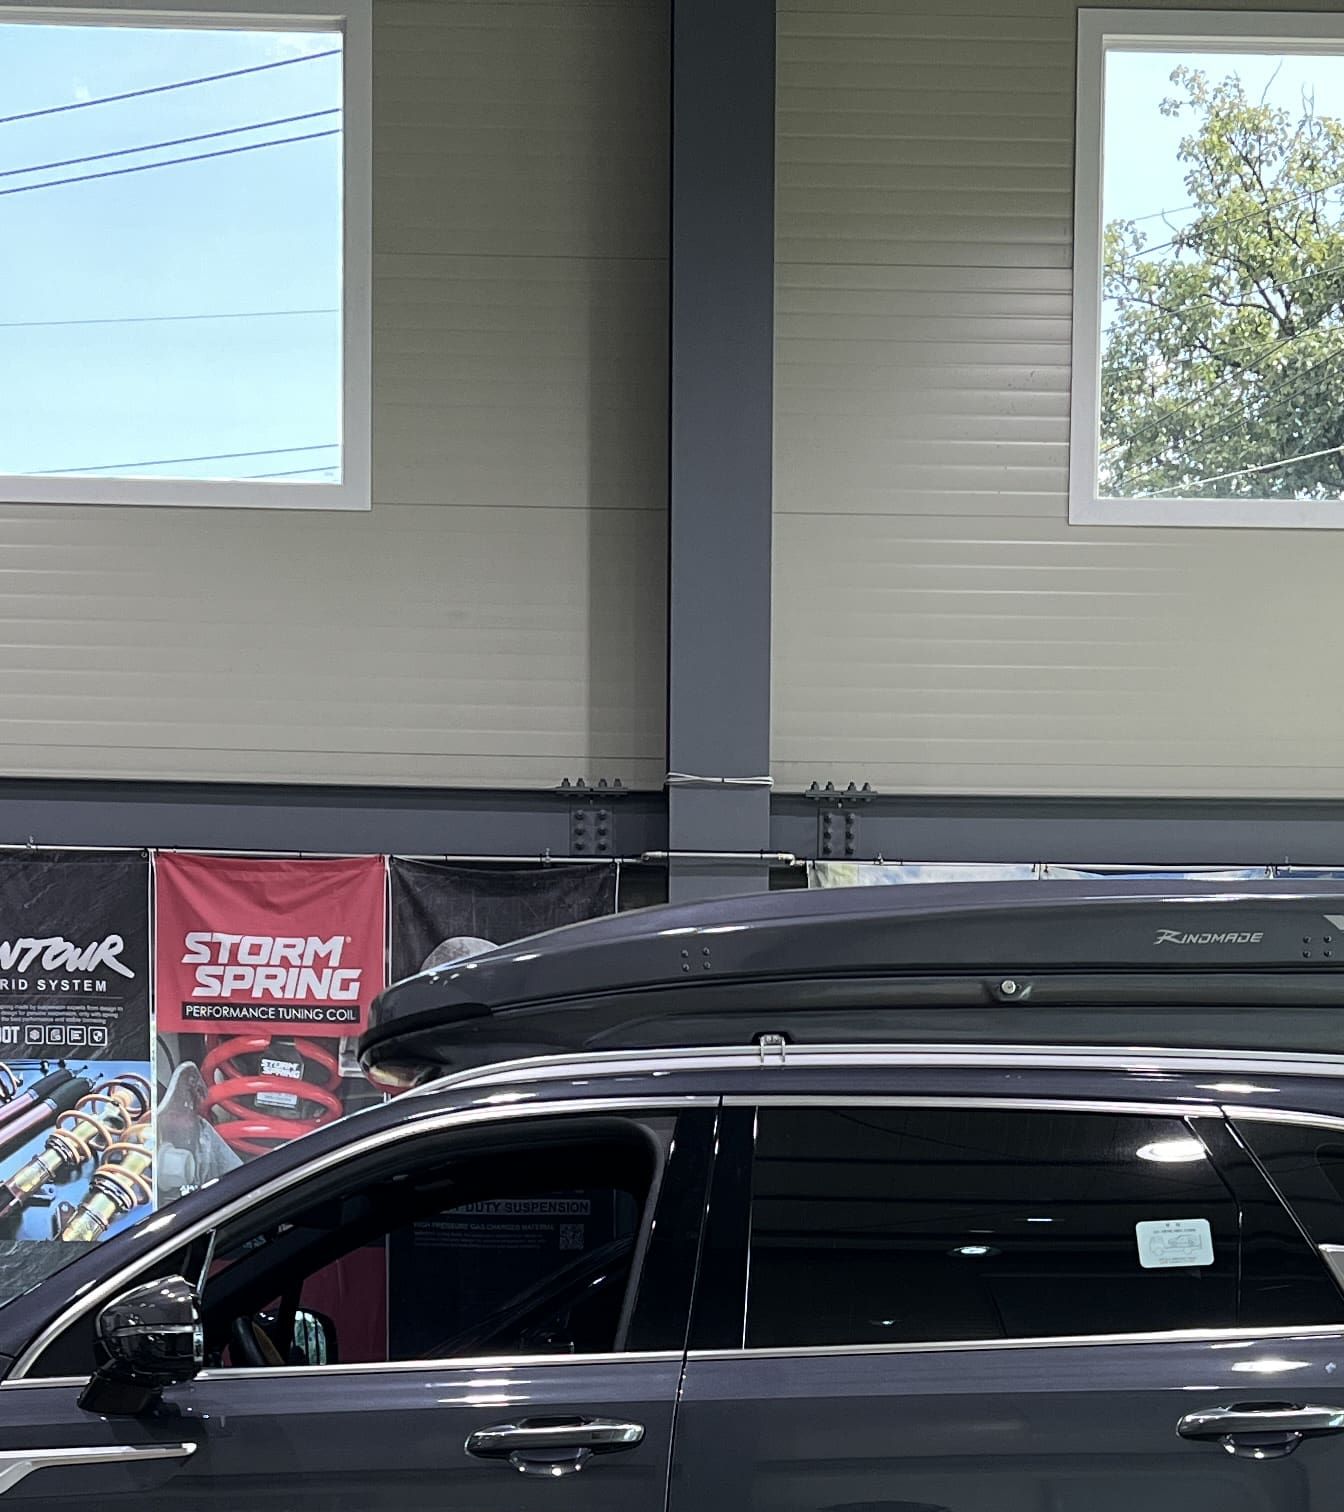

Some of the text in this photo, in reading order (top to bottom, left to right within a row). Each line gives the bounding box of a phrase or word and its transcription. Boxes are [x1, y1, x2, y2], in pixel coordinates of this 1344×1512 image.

[181, 931, 345, 968] STORM
[36, 978, 108, 993] SYSTEM
[191, 965, 363, 1001] SPRING
[185, 1005, 357, 1021] PERFORMANCE TUNING COIL
[504, 1201, 590, 1214] SUSPENSION
